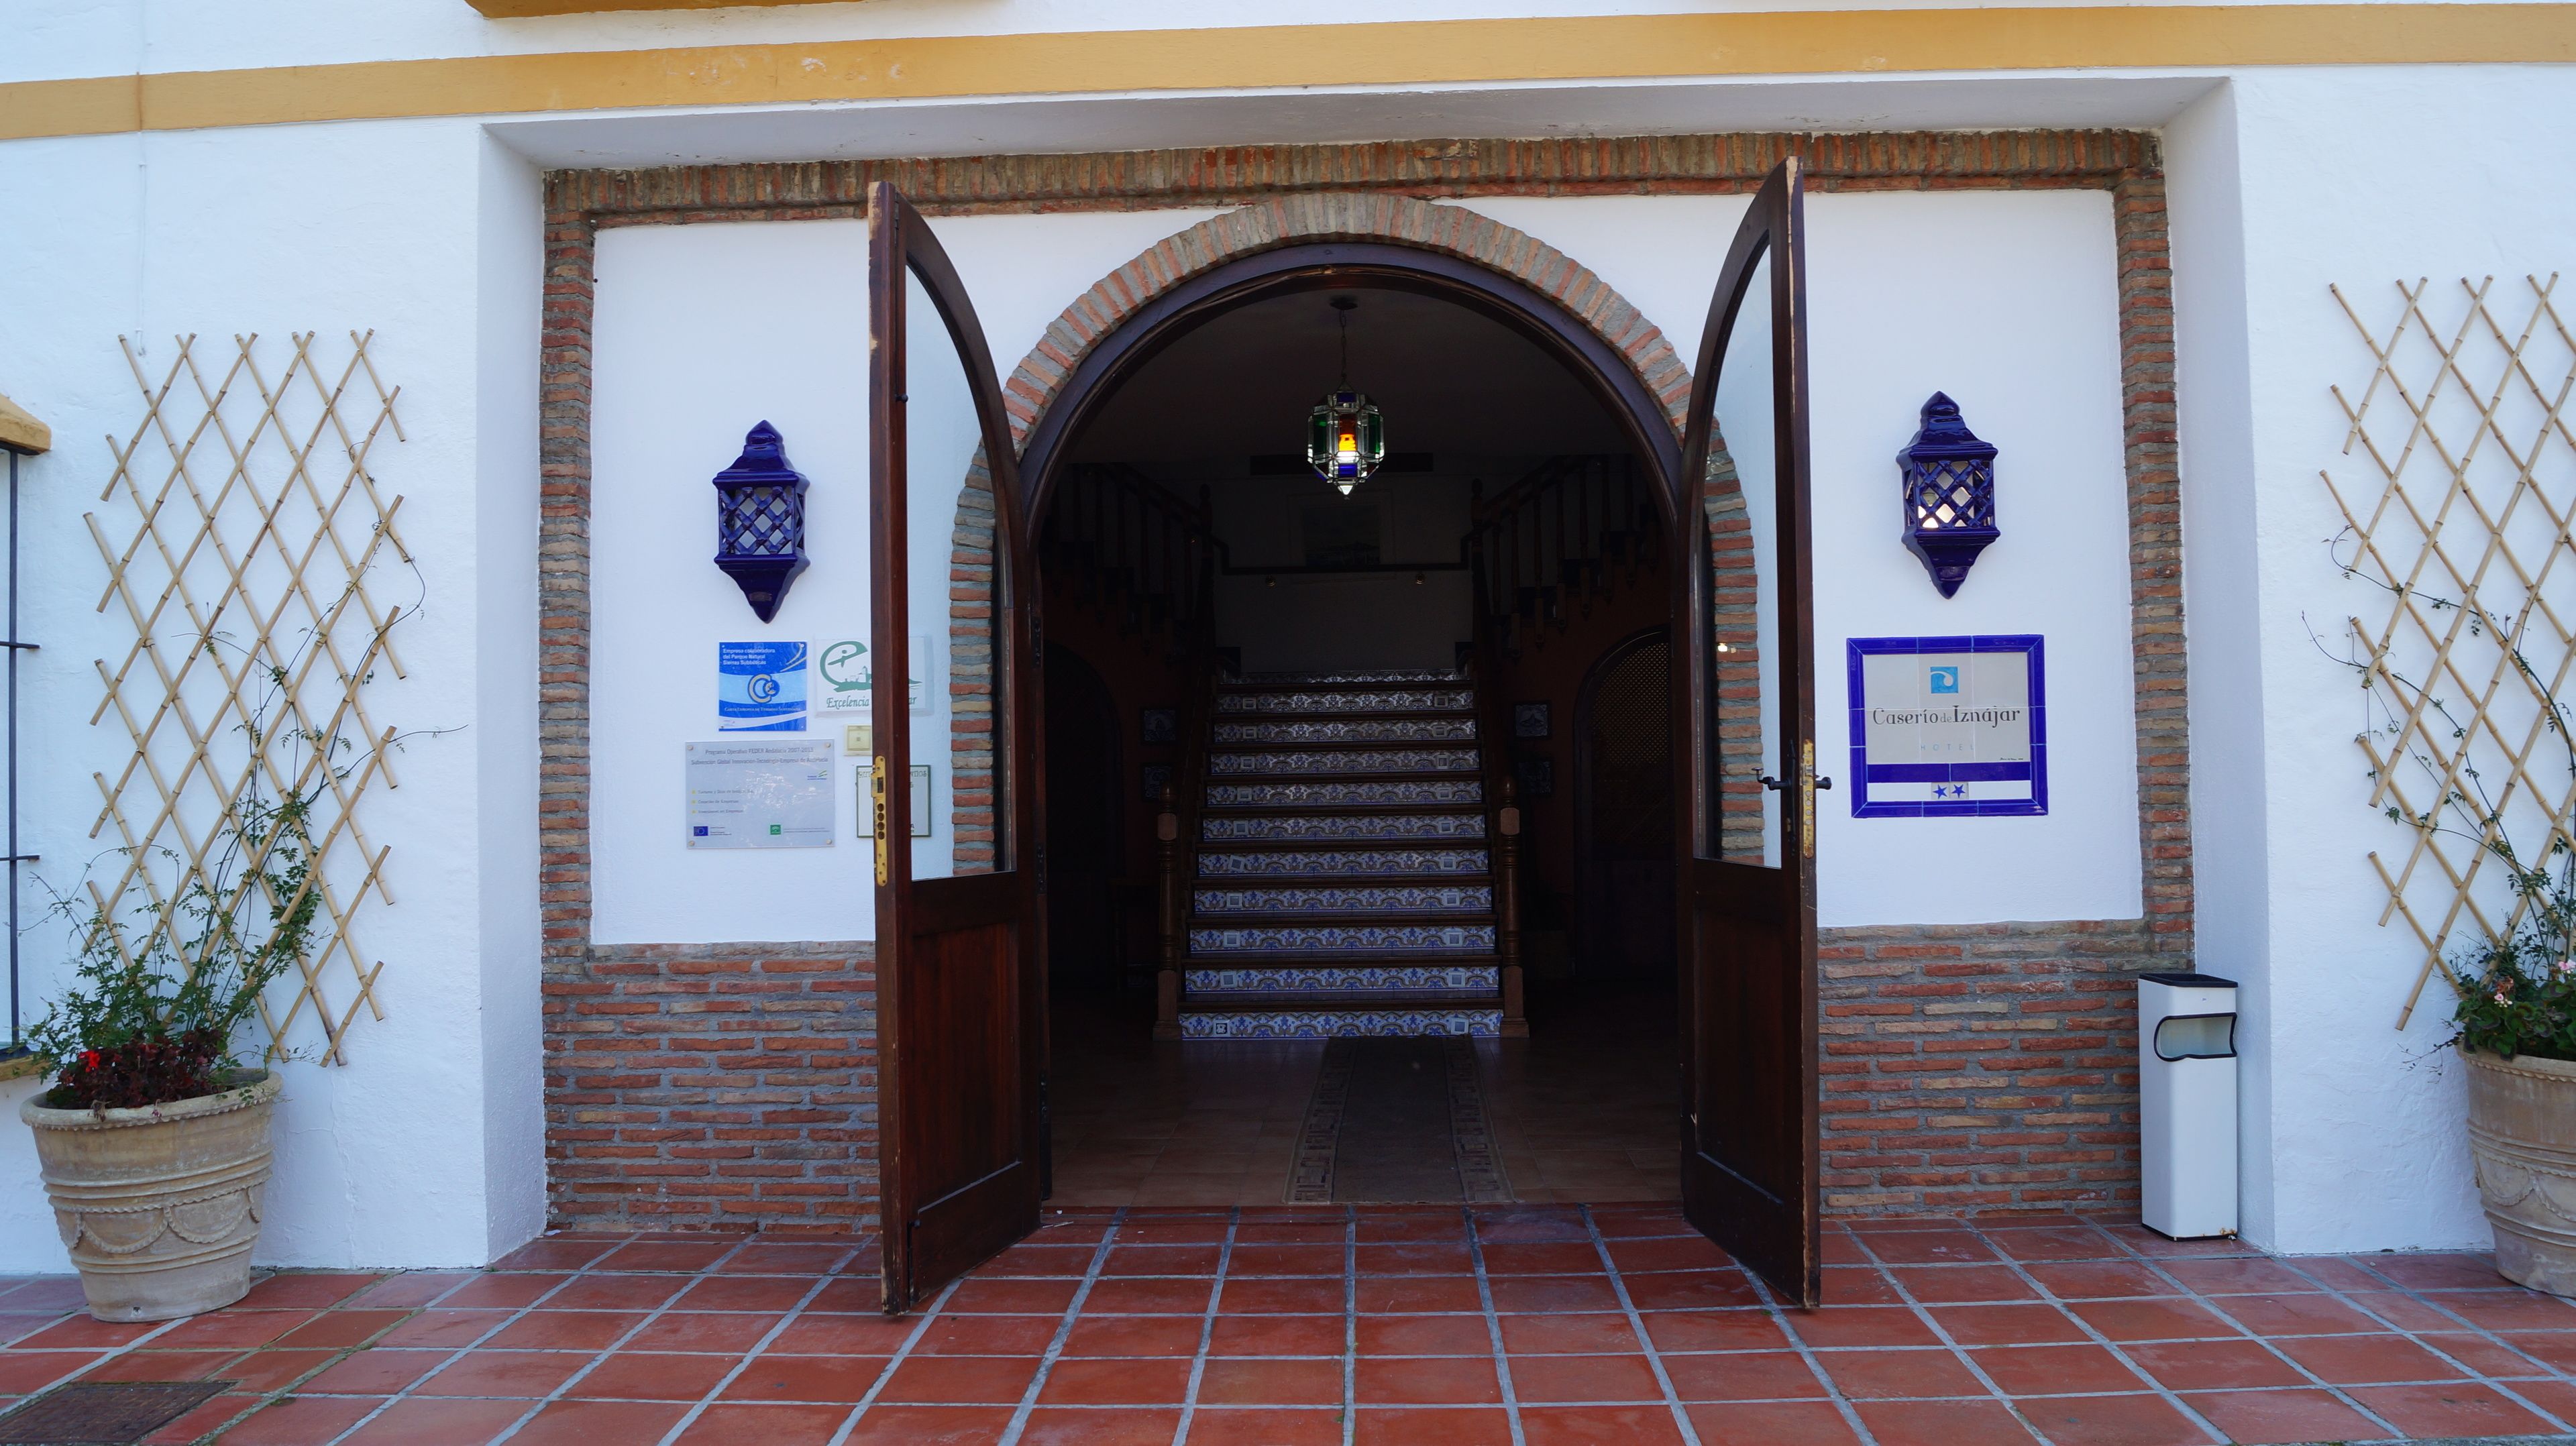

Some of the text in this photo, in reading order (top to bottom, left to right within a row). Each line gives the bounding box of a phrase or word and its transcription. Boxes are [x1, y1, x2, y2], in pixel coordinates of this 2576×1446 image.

[826, 695, 870, 710] Excelencia
[1873, 705, 2021, 728] Caserío de Iznájar
